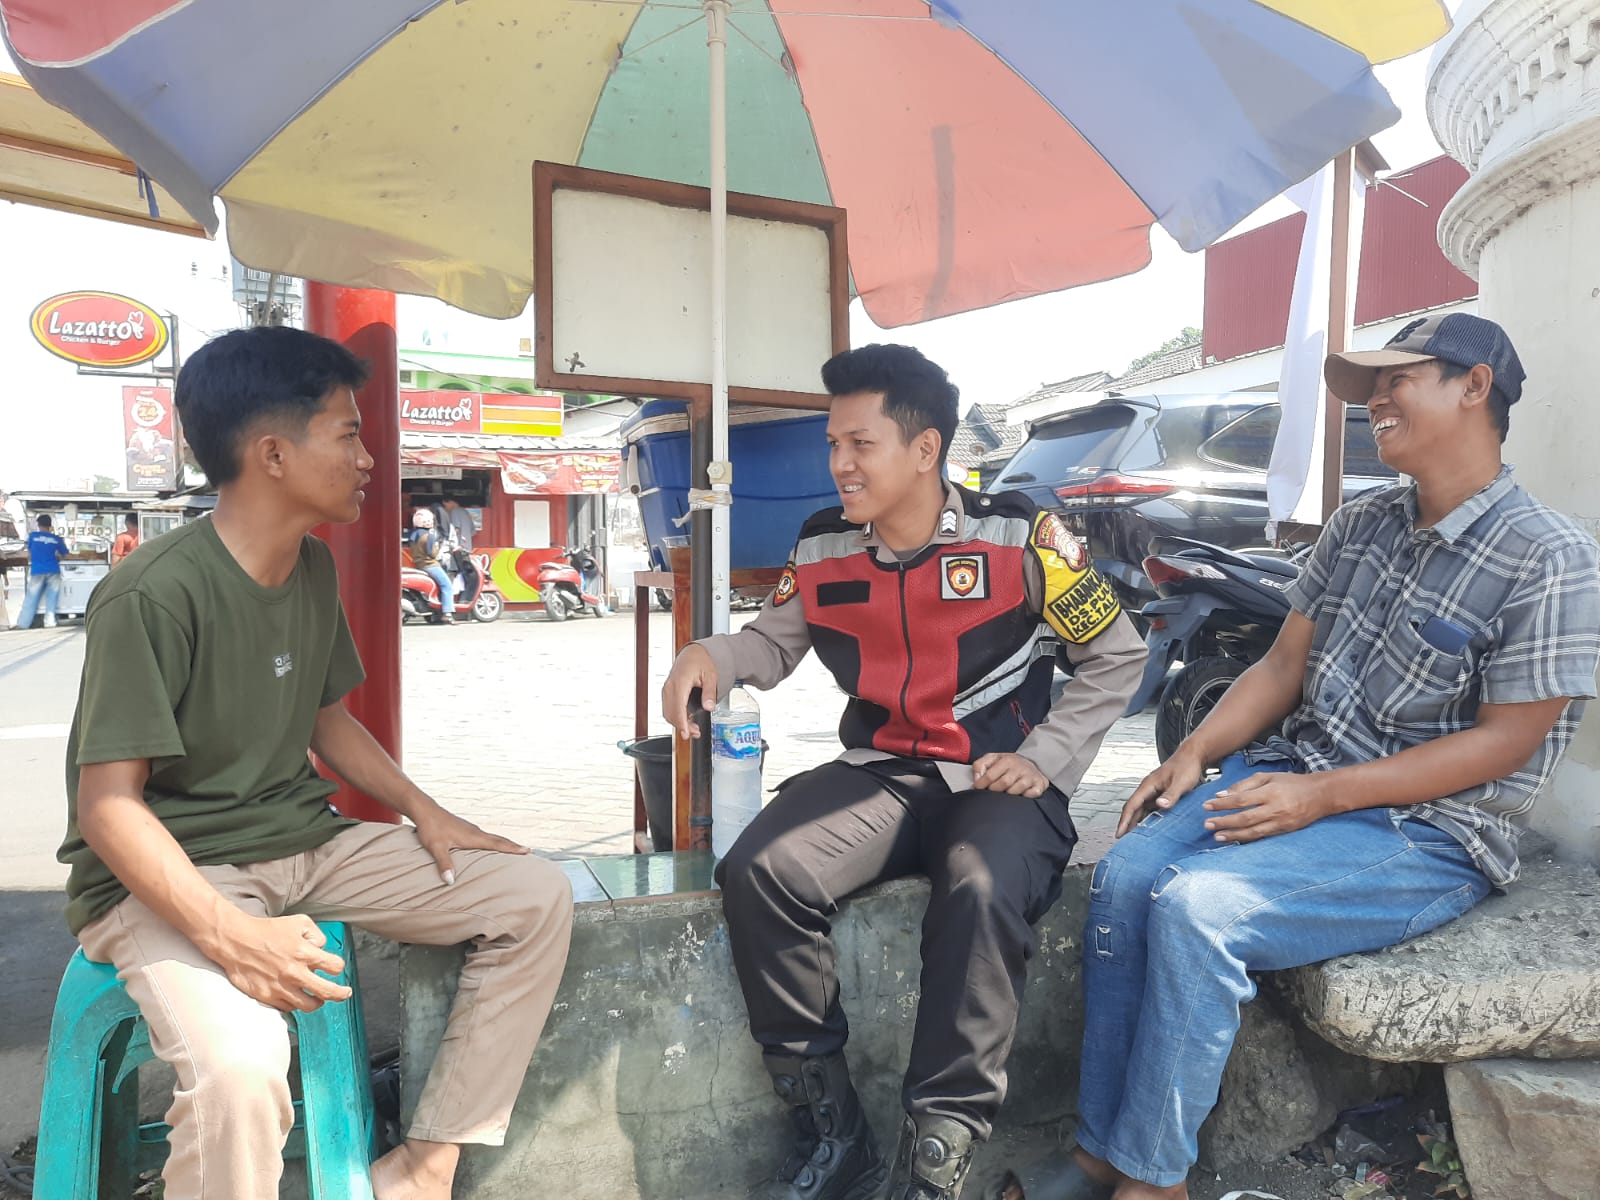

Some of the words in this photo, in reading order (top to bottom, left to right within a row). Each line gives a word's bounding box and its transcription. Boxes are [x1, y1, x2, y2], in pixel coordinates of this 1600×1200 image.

[48, 311, 133, 340] Lazatto
[401, 399, 463, 421] Lazatto
[1054, 570, 1101, 618] BHABINK
